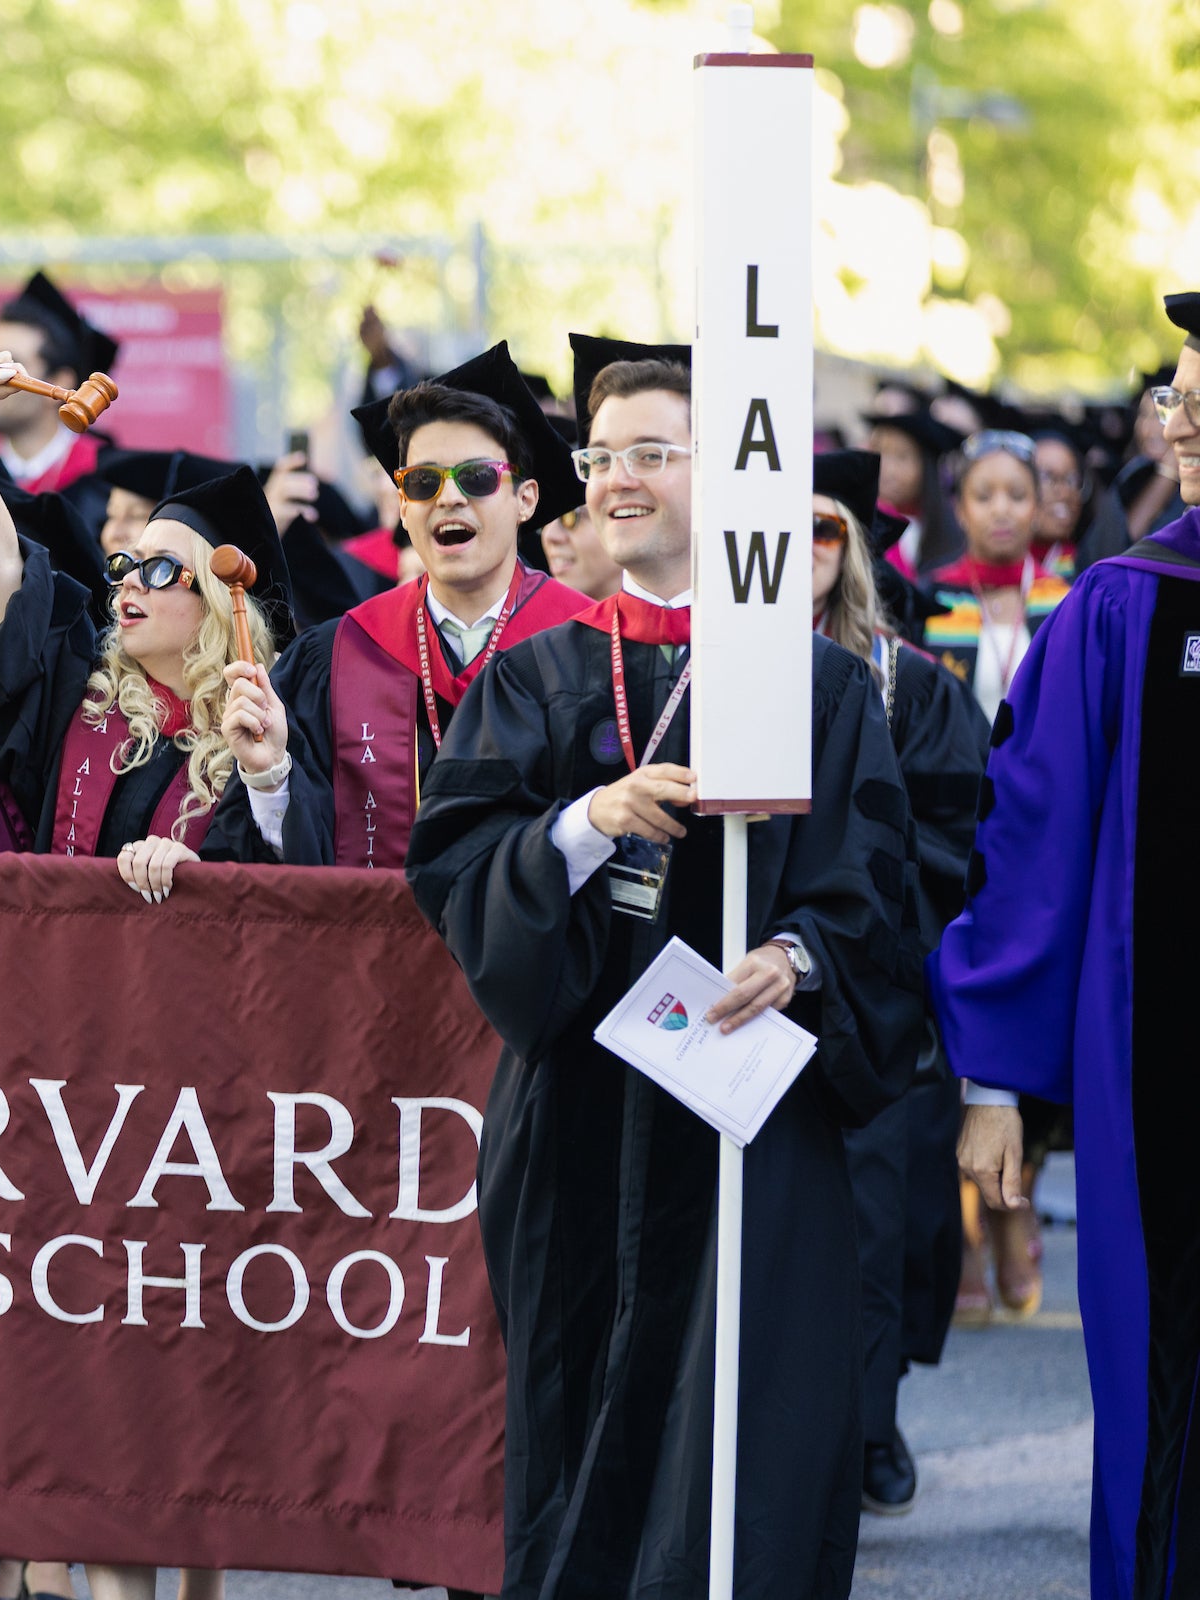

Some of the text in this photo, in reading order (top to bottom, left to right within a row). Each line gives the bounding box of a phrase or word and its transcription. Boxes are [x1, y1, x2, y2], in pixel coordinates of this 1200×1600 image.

[724, 265, 791, 603] LAW
[417, 607, 435, 711] COMMENCEMENT
[483, 607, 510, 668] IVERSITY
[361, 723, 376, 763] LA
[616, 685, 630, 743] HARVARD
